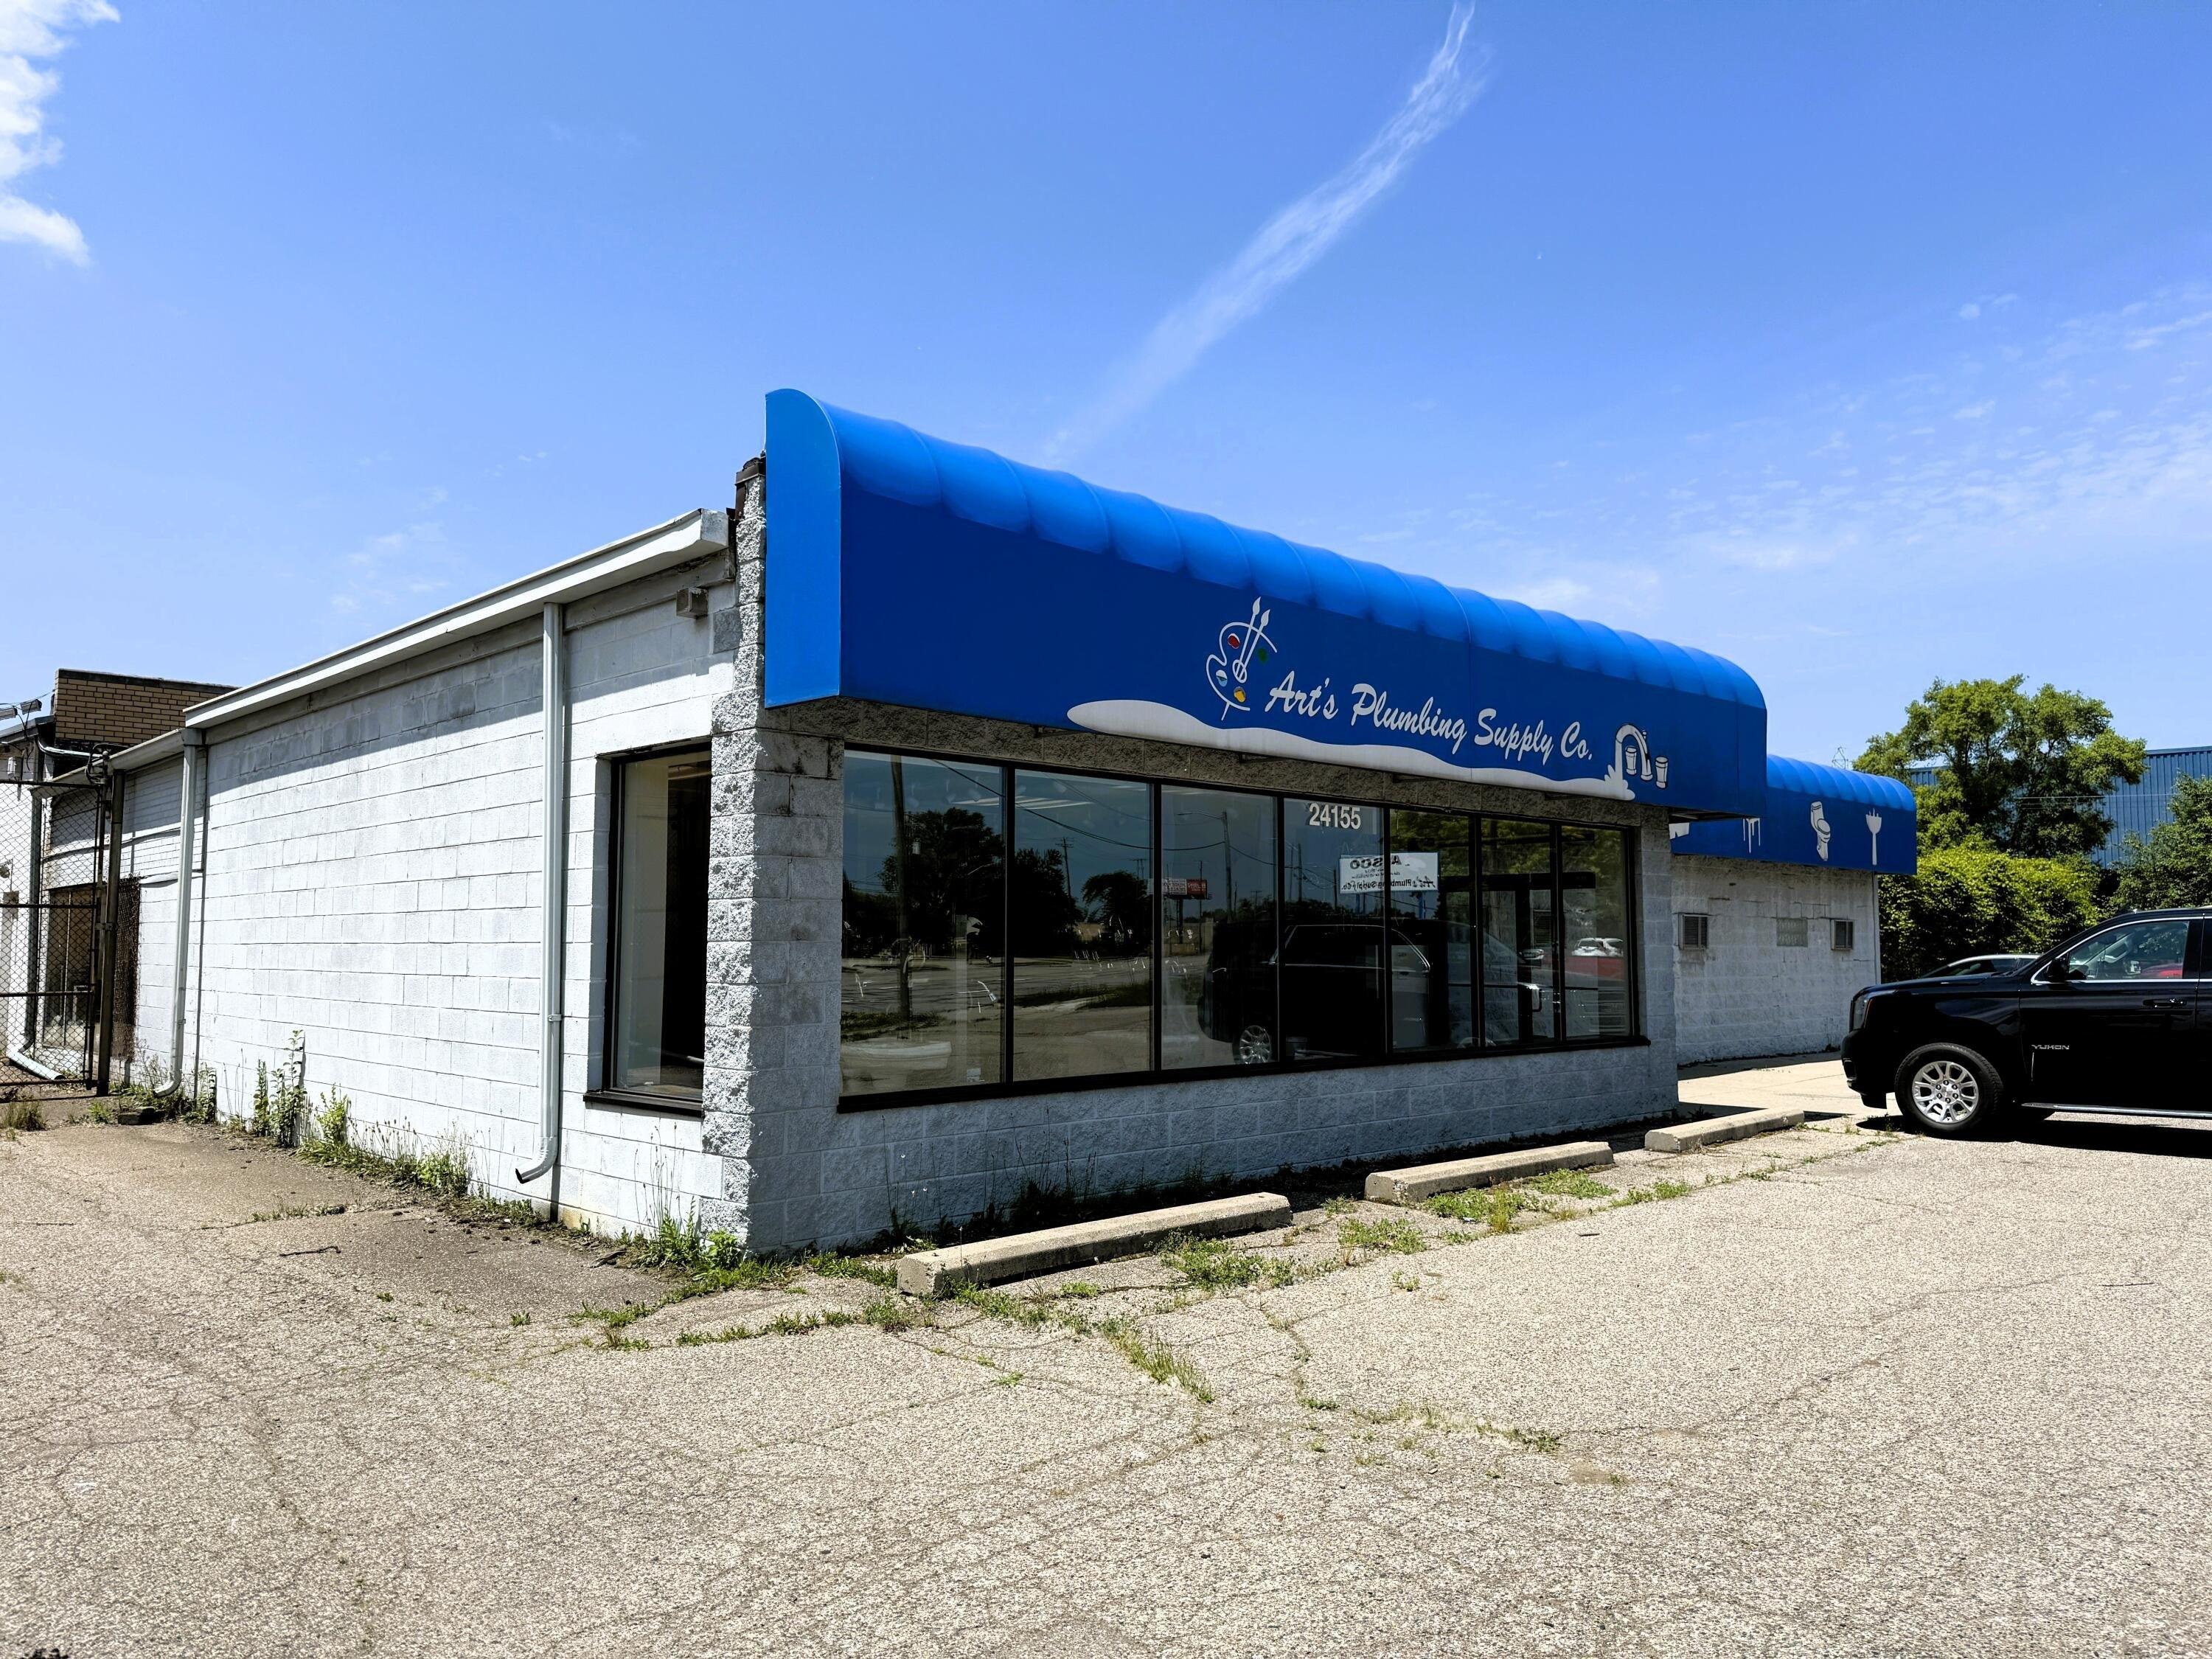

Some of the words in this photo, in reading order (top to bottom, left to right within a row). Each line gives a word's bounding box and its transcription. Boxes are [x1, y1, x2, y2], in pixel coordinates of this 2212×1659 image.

[1265, 670, 1338, 720] Art's
[1351, 683, 1467, 755] Plumbing
[1474, 708, 1554, 765] Supply
[1560, 721, 1593, 760] Co.
[1309, 803, 1361, 830] 24155
